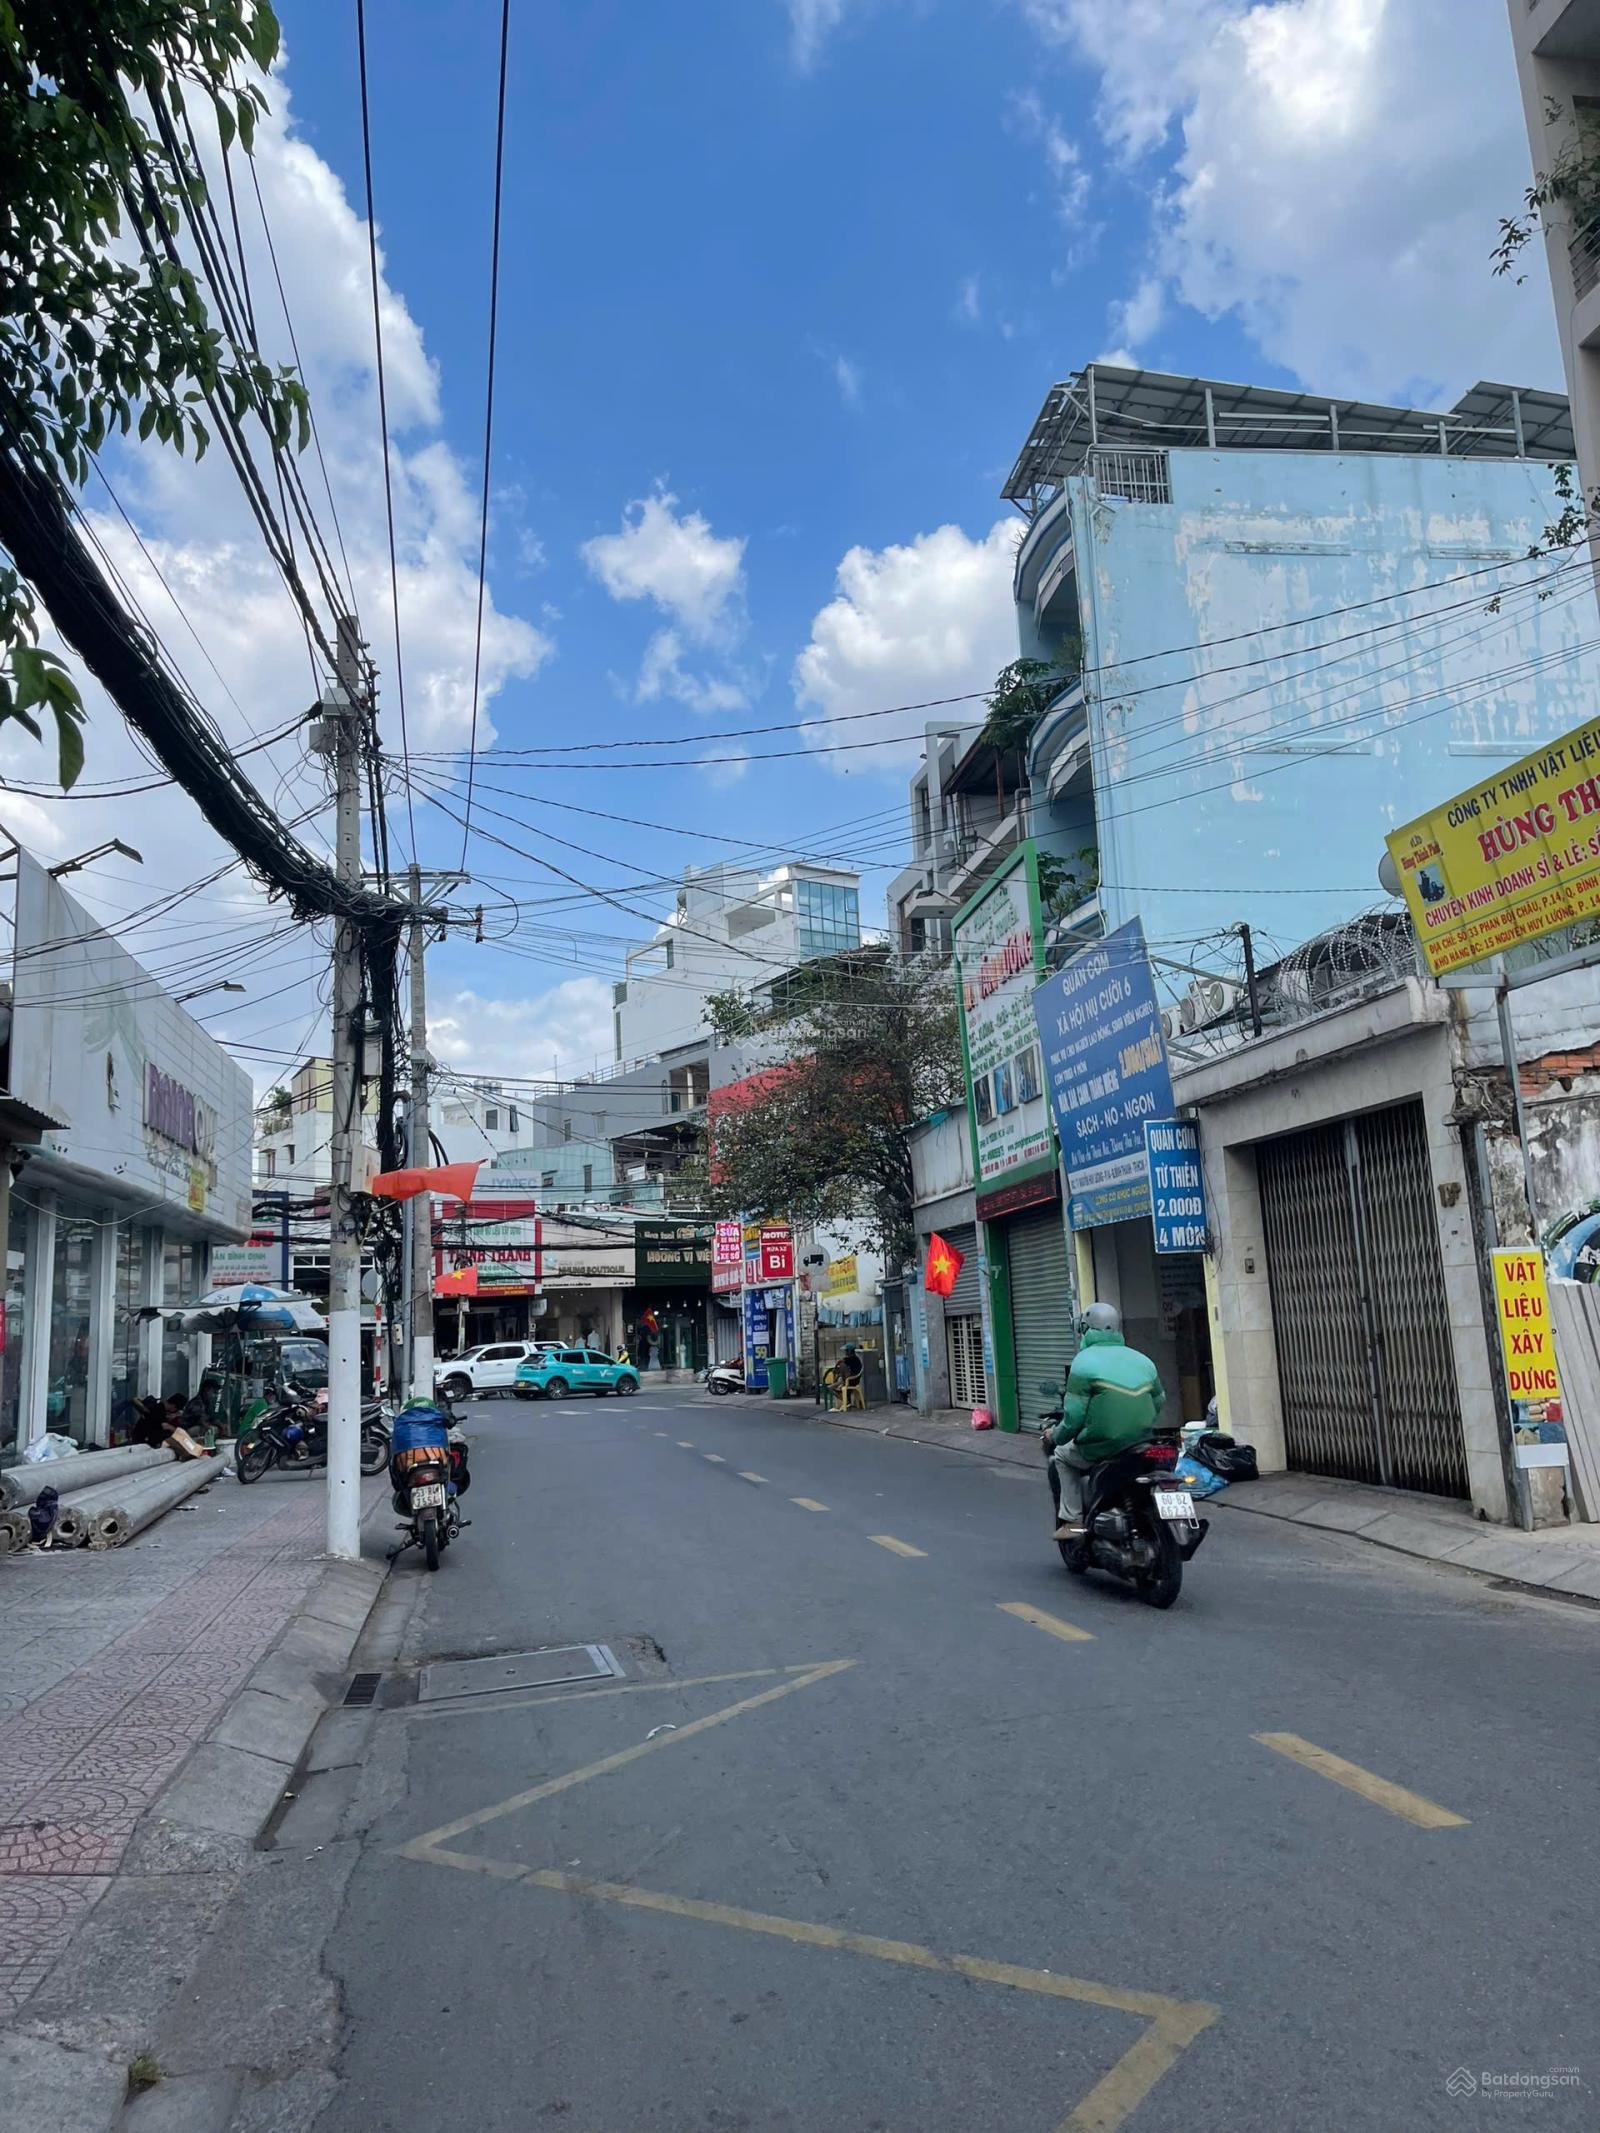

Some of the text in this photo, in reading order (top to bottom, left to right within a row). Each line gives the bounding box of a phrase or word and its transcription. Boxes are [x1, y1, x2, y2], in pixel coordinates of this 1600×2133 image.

[1447, 798, 1481, 828] CÔNG
[1481, 787, 1498, 809] TY
[1500, 766, 1538, 799] TNHH
[1538, 750, 1567, 778] VẬT
[1478, 773, 1600, 862] HÙNG TH
[1425, 896, 1467, 928] CHUYÊN
[1466, 882, 1495, 910] KINH
[1495, 866, 1536, 897] DOANH
[1537, 852, 1552, 879] SỈ
[1552, 854, 1564, 872] &
[1564, 838, 1588, 867] LẺ:
[1468, 925, 1479, 938] 33
[1479, 912, 1501, 934] PHAN
[1576, 874, 1599, 895] BÌNH
[1433, 953, 1451, 971] KHO
[1450, 945, 1470, 965] HÀNG
[1484, 936, 1495, 950] 15
[1527, 917, 1544, 933] HUY
[1063, 968, 1086, 996] QUÁN
[1057, 1011, 1071, 1037] XÃ
[1069, 1003, 1086, 1031] HỘI
[1085, 995, 1099, 1021] NỤ
[1100, 979, 1124, 1011] CƯỜI
[1124, 976, 1131, 997] 6
[1076, 1091, 1156, 1141] SẠCH NO NGON
[1150, 1124, 1175, 1153] QUÁN
[1175, 1126, 1198, 1151] CƠM
[1155, 1161, 1168, 1189] TỪ
[1169, 1161, 1199, 1193] THIỆN
[1157, 1197, 1203, 1218] 2.000Đ
[719, 1224, 740, 1237] SỬA
[762, 1231, 791, 1240] MOTU
[1160, 1222, 1206, 1247] 4 MÓN
[695, 1247, 712, 1264] VIỆ
[720, 1244, 740, 1252] XE GA
[720, 1250, 740, 1260] XE SỐ
[770, 1255, 786, 1269] Bi
[586, 1265, 625, 1275] BOUTIQUE
[1504, 1257, 1536, 1286] VẬT
[1504, 1293, 1542, 1321] LIỆU
[1512, 1330, 1543, 1354] XÂY
[1509, 1367, 1557, 1395] DỰNG
